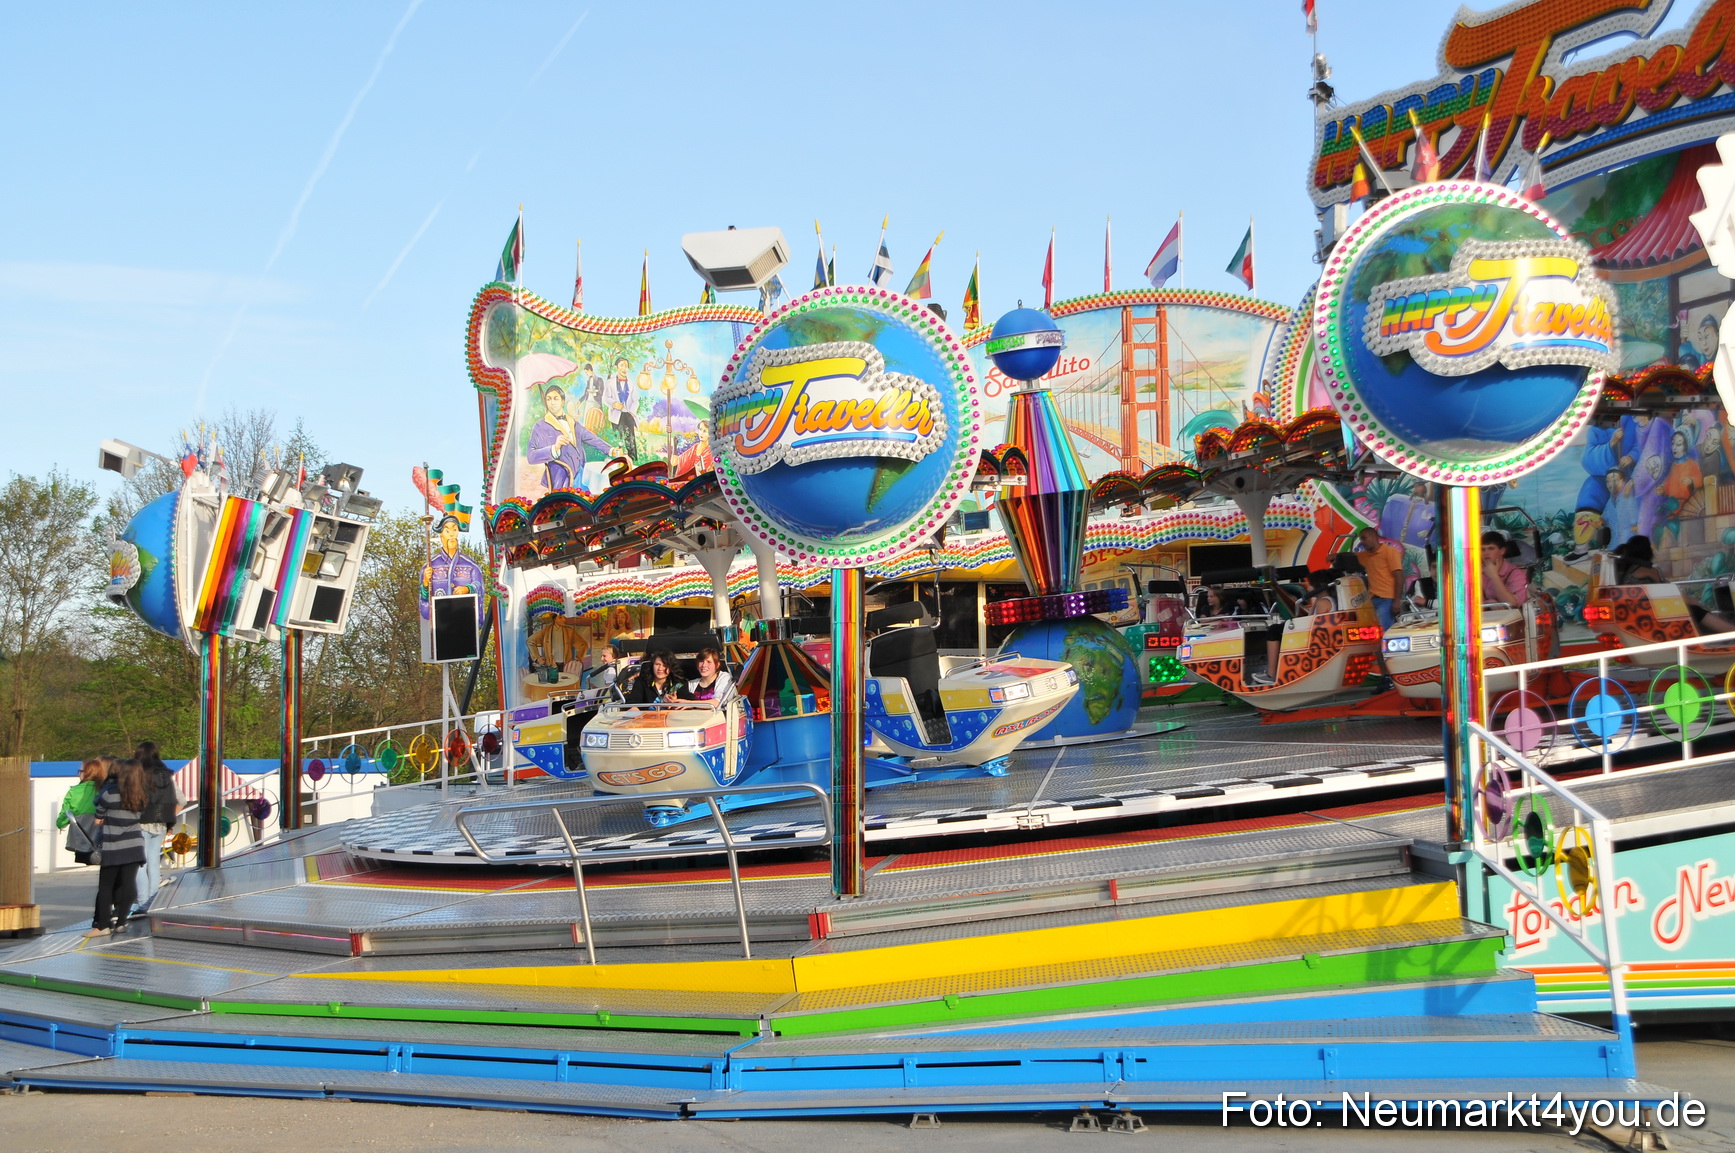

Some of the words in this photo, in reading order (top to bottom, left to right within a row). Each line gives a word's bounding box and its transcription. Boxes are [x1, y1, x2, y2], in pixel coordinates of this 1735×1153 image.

[1380, 284, 1498, 340] HAPPY
[716, 388, 783, 441] HAPPY
[735, 357, 935, 458] Traveller
[602, 772, 648, 784] LET'S
[648, 763, 683, 778] GO
